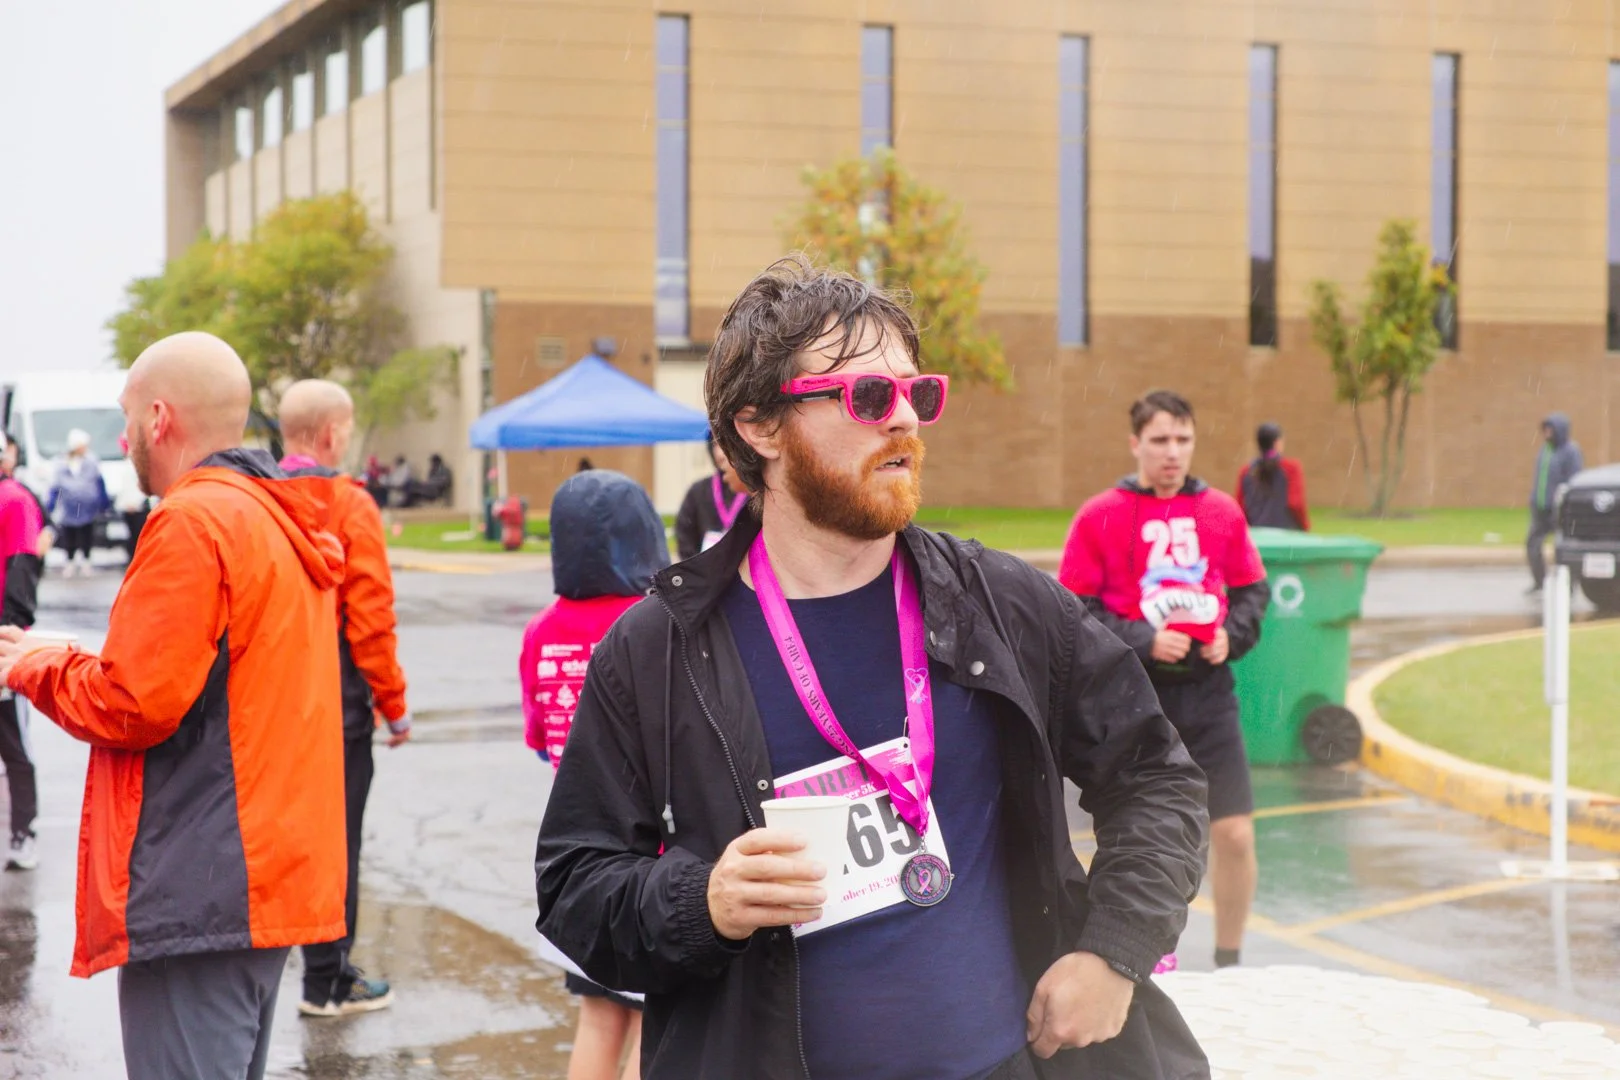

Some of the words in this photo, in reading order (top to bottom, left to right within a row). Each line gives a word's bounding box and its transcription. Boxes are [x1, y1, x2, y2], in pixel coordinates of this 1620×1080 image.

[1141, 516, 1201, 569] 25
[799, 673, 812, 688] OF
[807, 689, 830, 727] YEARS
[860, 781, 877, 794] 5K
[843, 794, 921, 875] 65
[842, 885, 868, 902] ober
